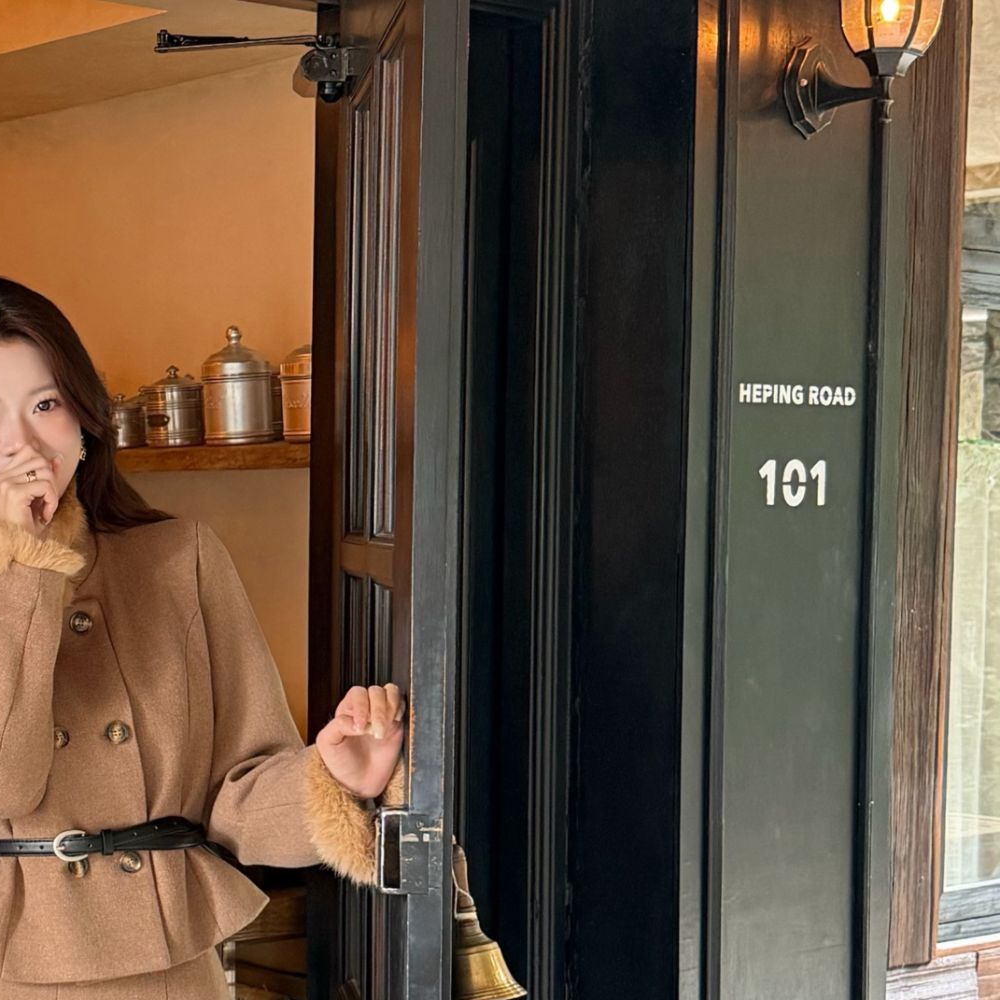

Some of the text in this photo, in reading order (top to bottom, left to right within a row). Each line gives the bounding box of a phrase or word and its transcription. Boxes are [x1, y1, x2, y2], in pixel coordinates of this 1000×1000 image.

[739, 383, 856, 406] HEPING ROAD
[758, 458, 826, 507] 101
